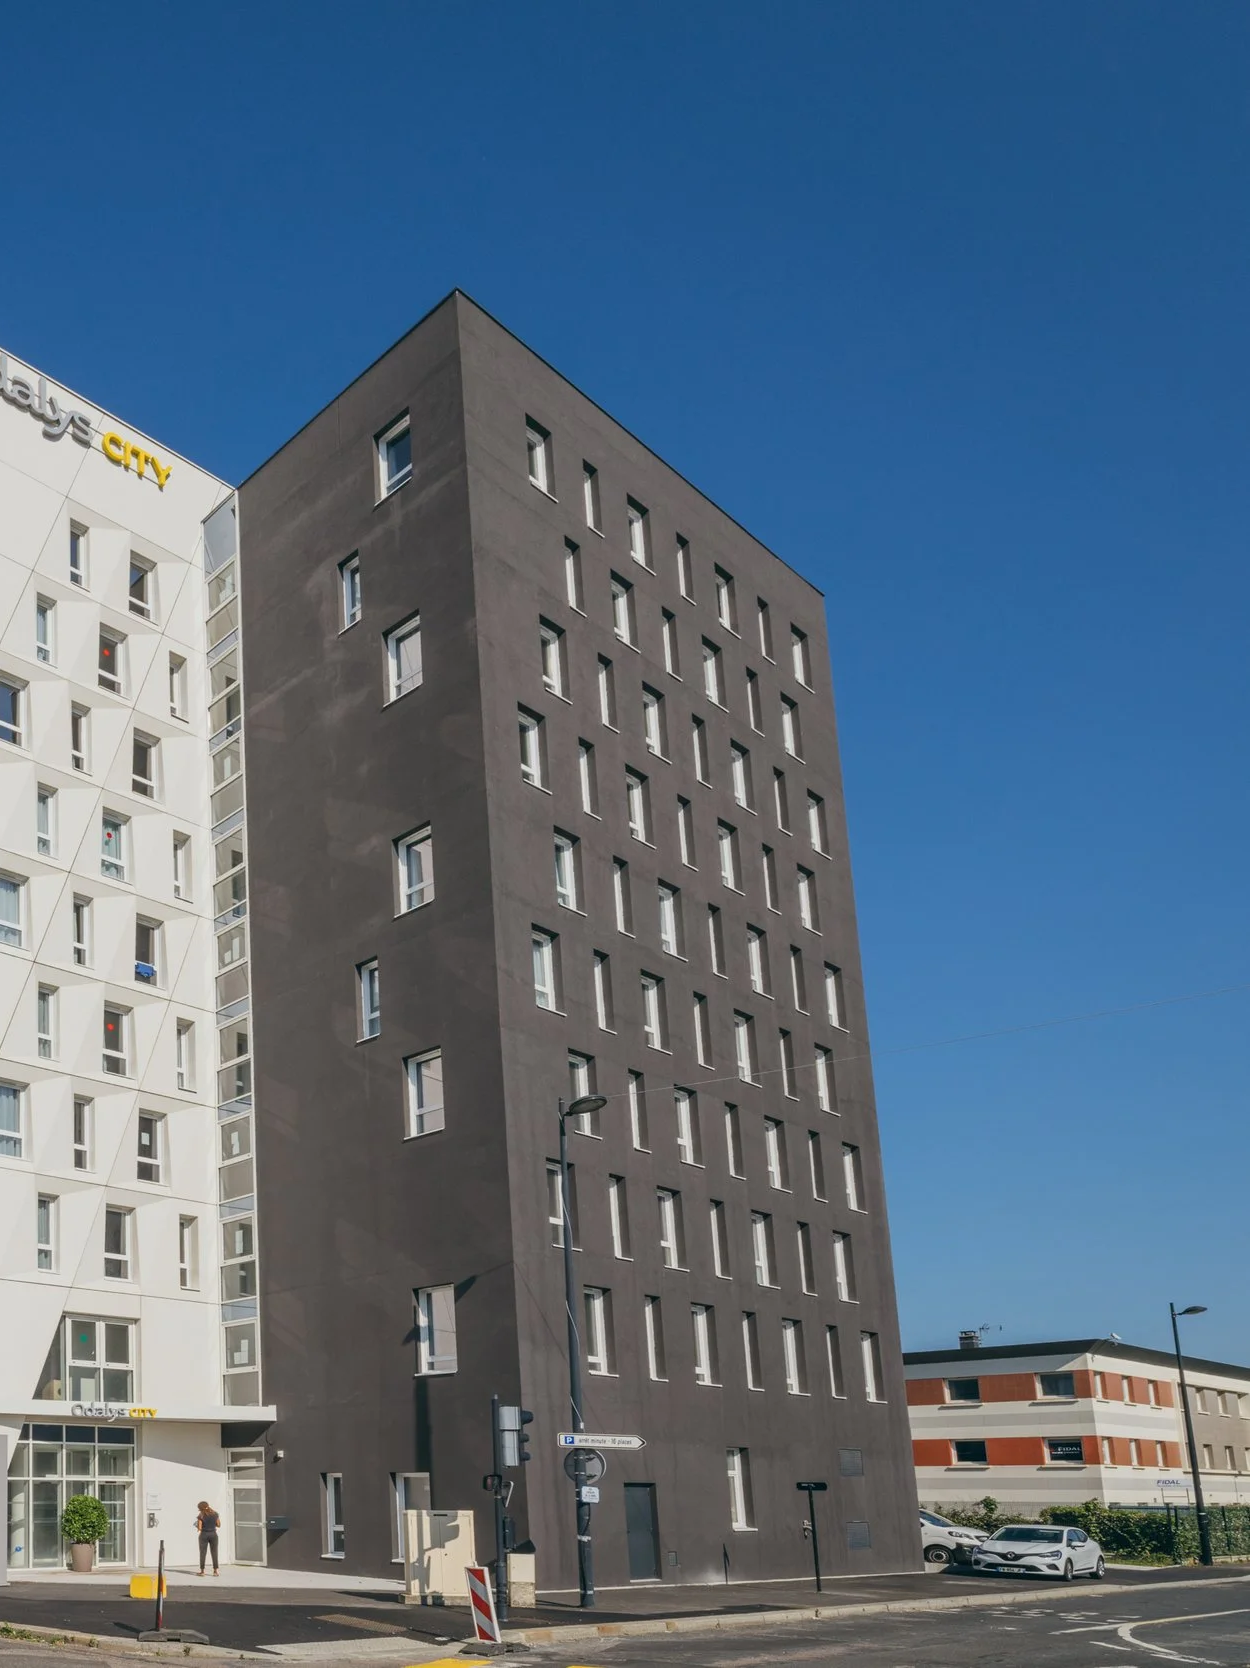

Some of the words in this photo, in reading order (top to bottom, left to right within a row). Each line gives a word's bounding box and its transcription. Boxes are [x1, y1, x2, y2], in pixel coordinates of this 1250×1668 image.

[102, 431, 173, 489] CITY
[71, 1401, 126, 1422] Odalys
[128, 1407, 158, 1419] CITY
